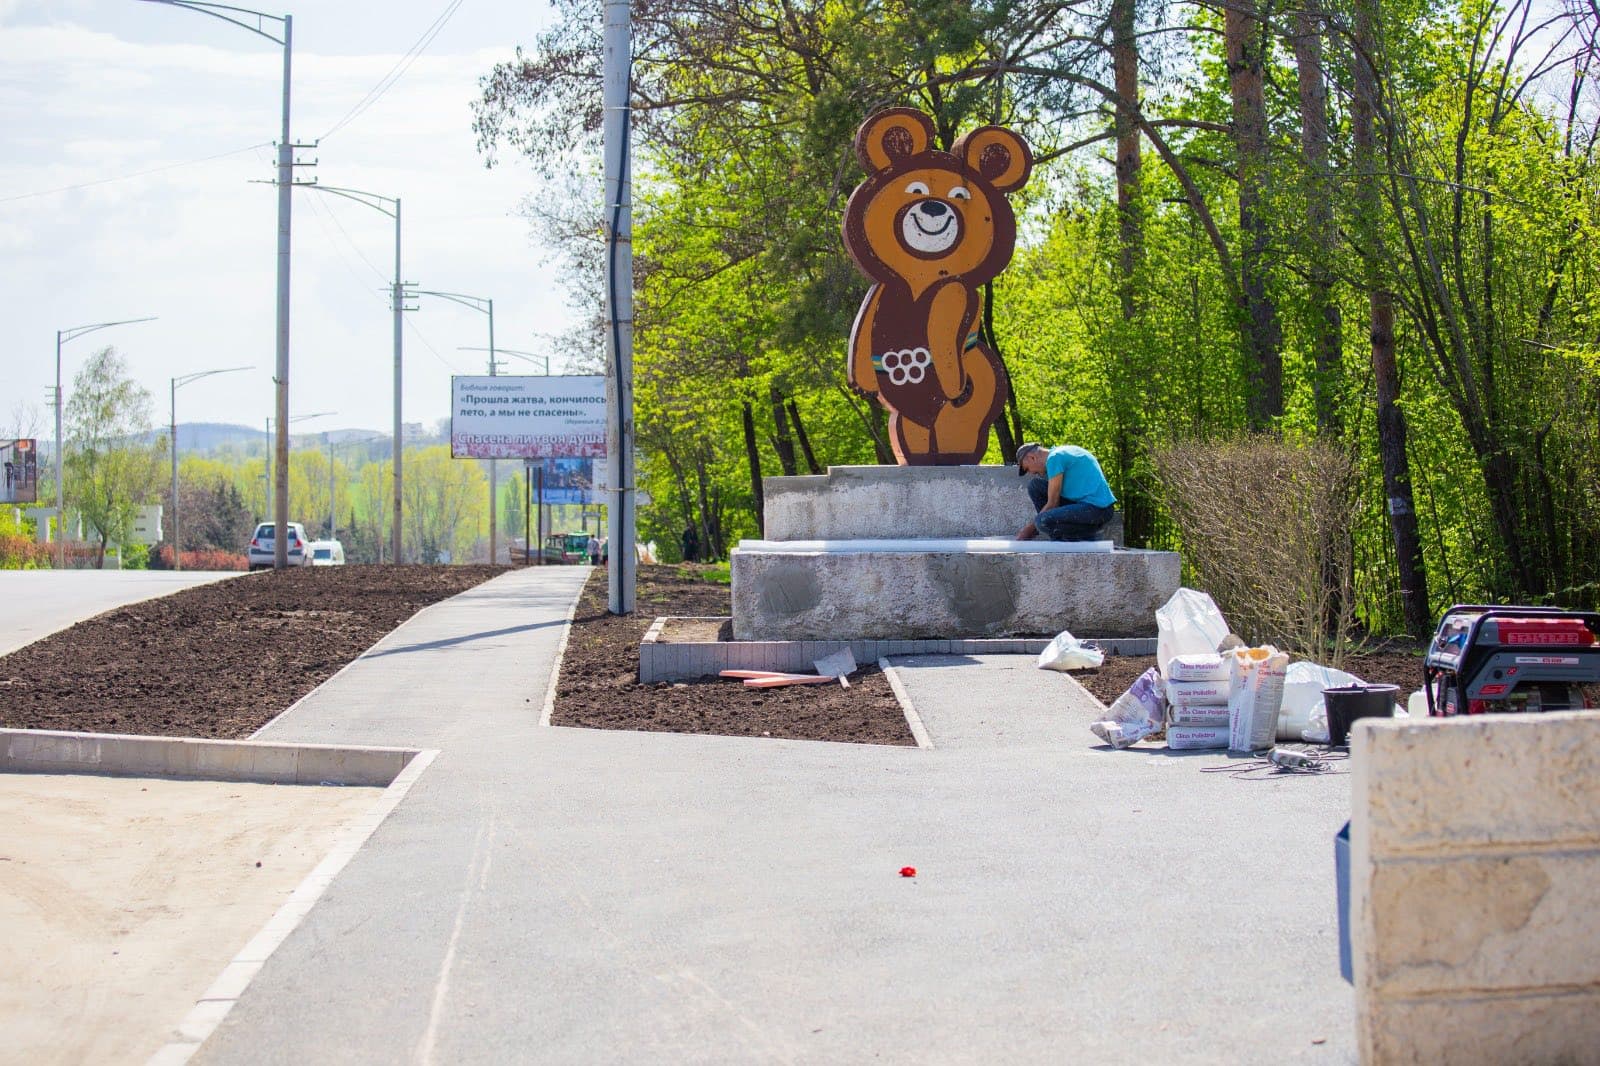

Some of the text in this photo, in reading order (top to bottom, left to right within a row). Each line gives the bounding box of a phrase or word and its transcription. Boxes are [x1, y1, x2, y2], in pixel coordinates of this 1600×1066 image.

[460, 394, 607, 406] «Прошла жатва, кончилось
[460, 408, 587, 418] лето, а мы не спасены».
[458, 433, 513, 445] Спасена
[514, 434, 532, 445] ли
[535, 434, 566, 445] твоя
